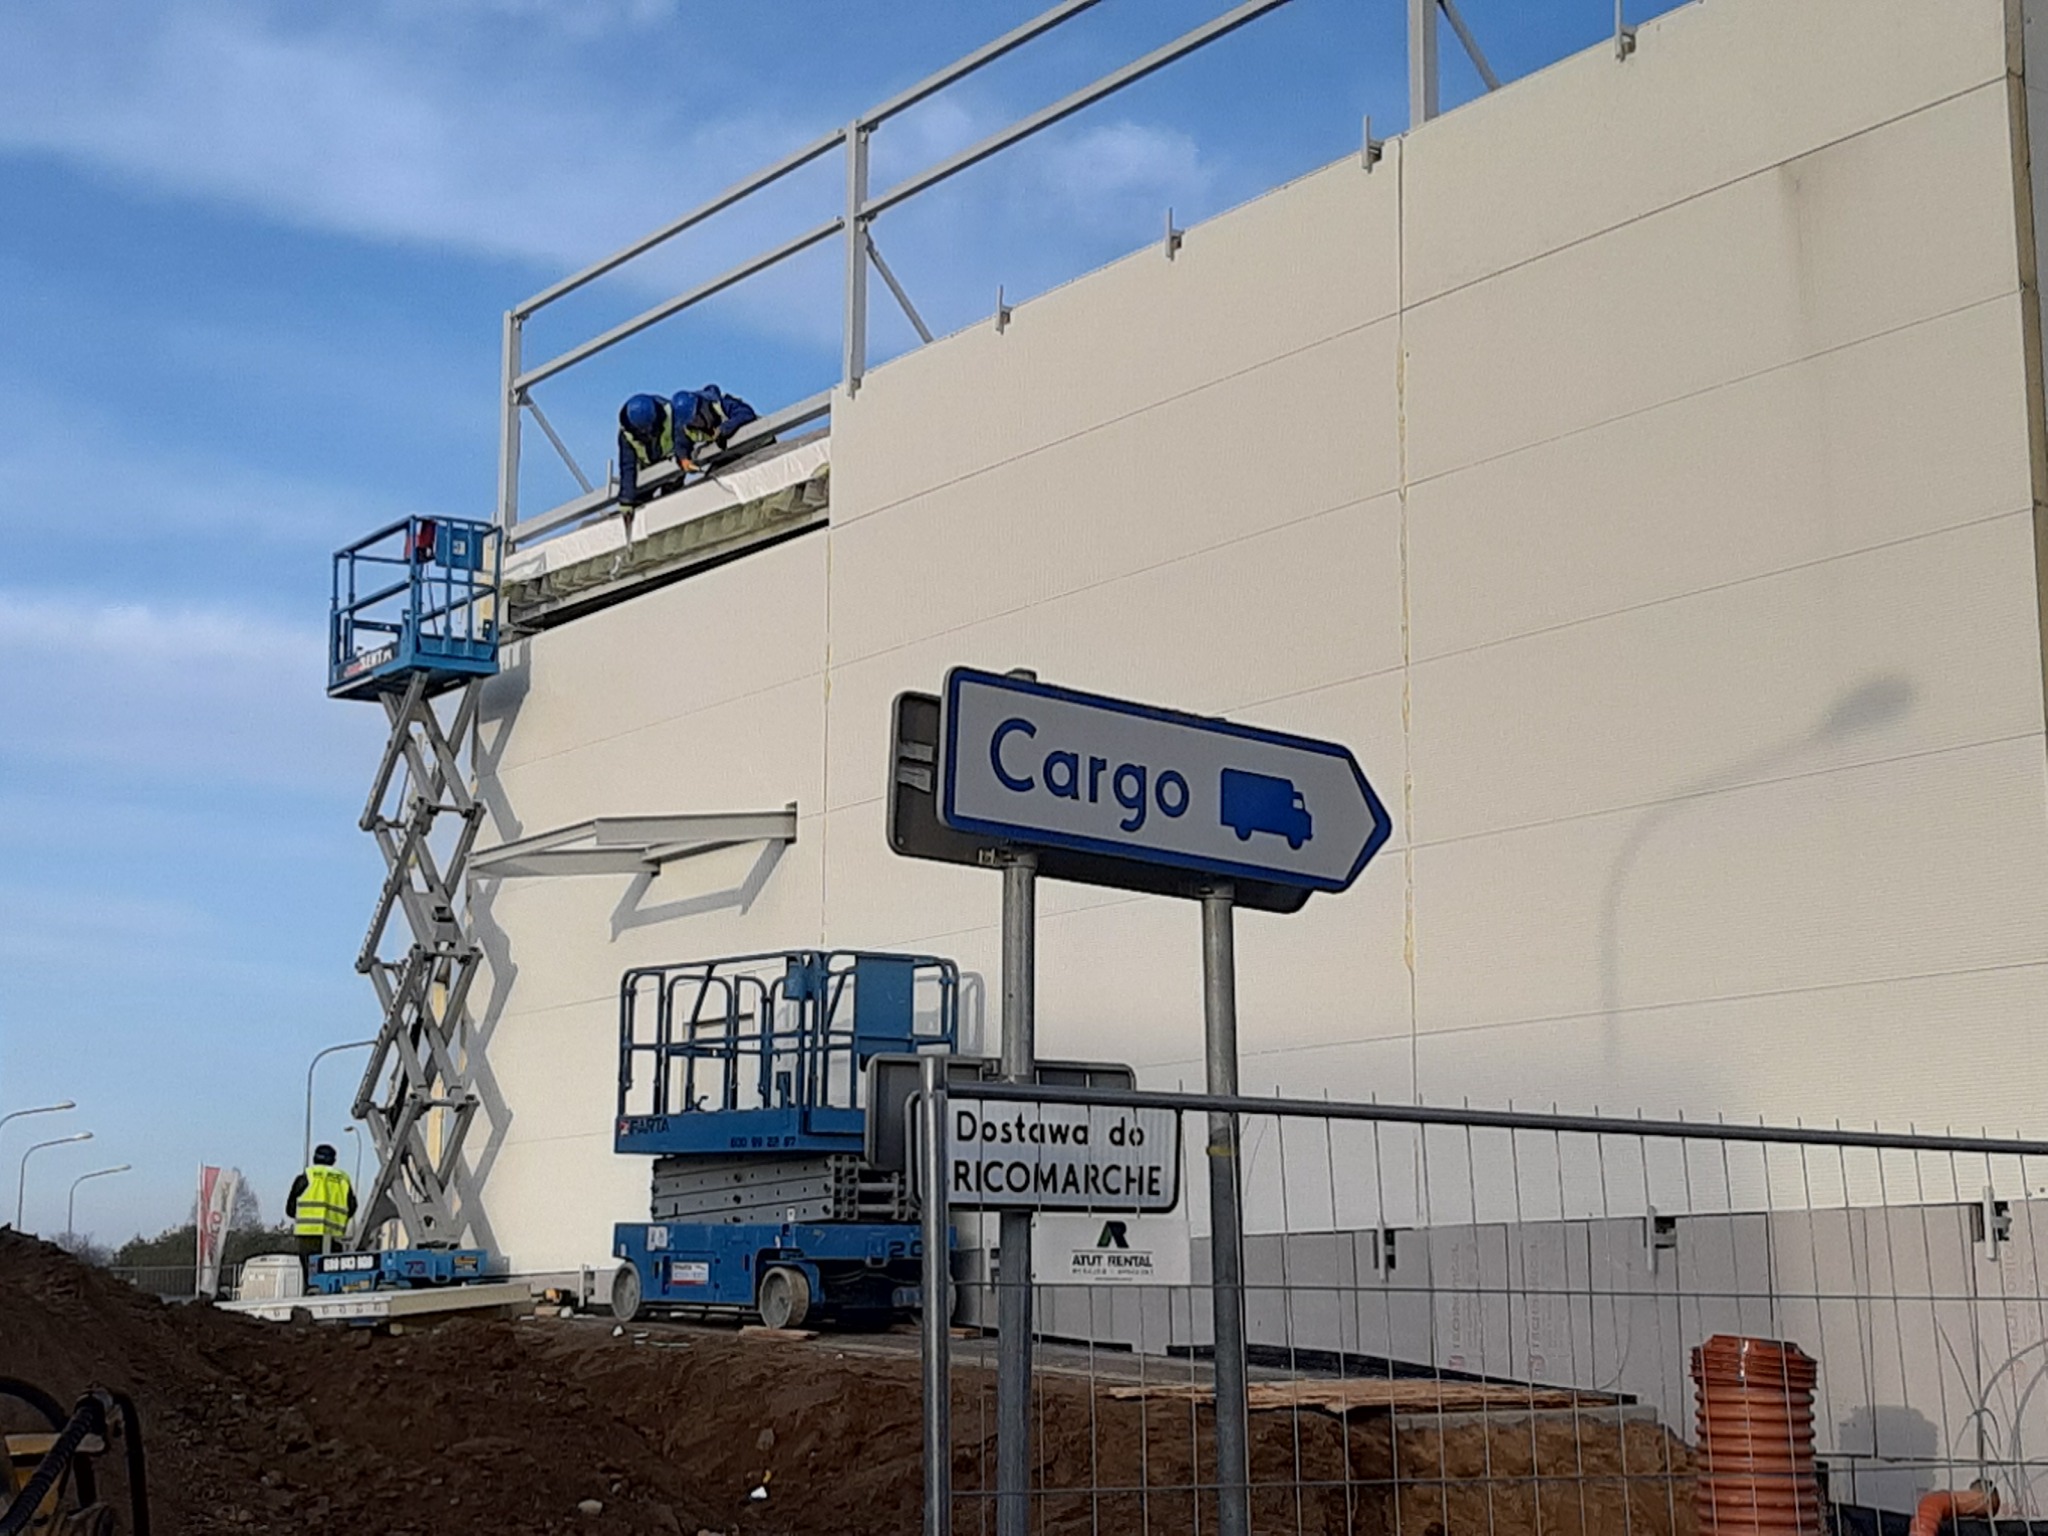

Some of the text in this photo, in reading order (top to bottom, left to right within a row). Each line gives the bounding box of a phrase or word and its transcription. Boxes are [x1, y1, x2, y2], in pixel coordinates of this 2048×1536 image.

[990, 717, 1190, 833] Cargo
[956, 1110, 1145, 1147] Dostawa do
[954, 1160, 1162, 1196] RICOMARCHE
[1072, 1254, 1153, 1268] ATUT RENTAL
